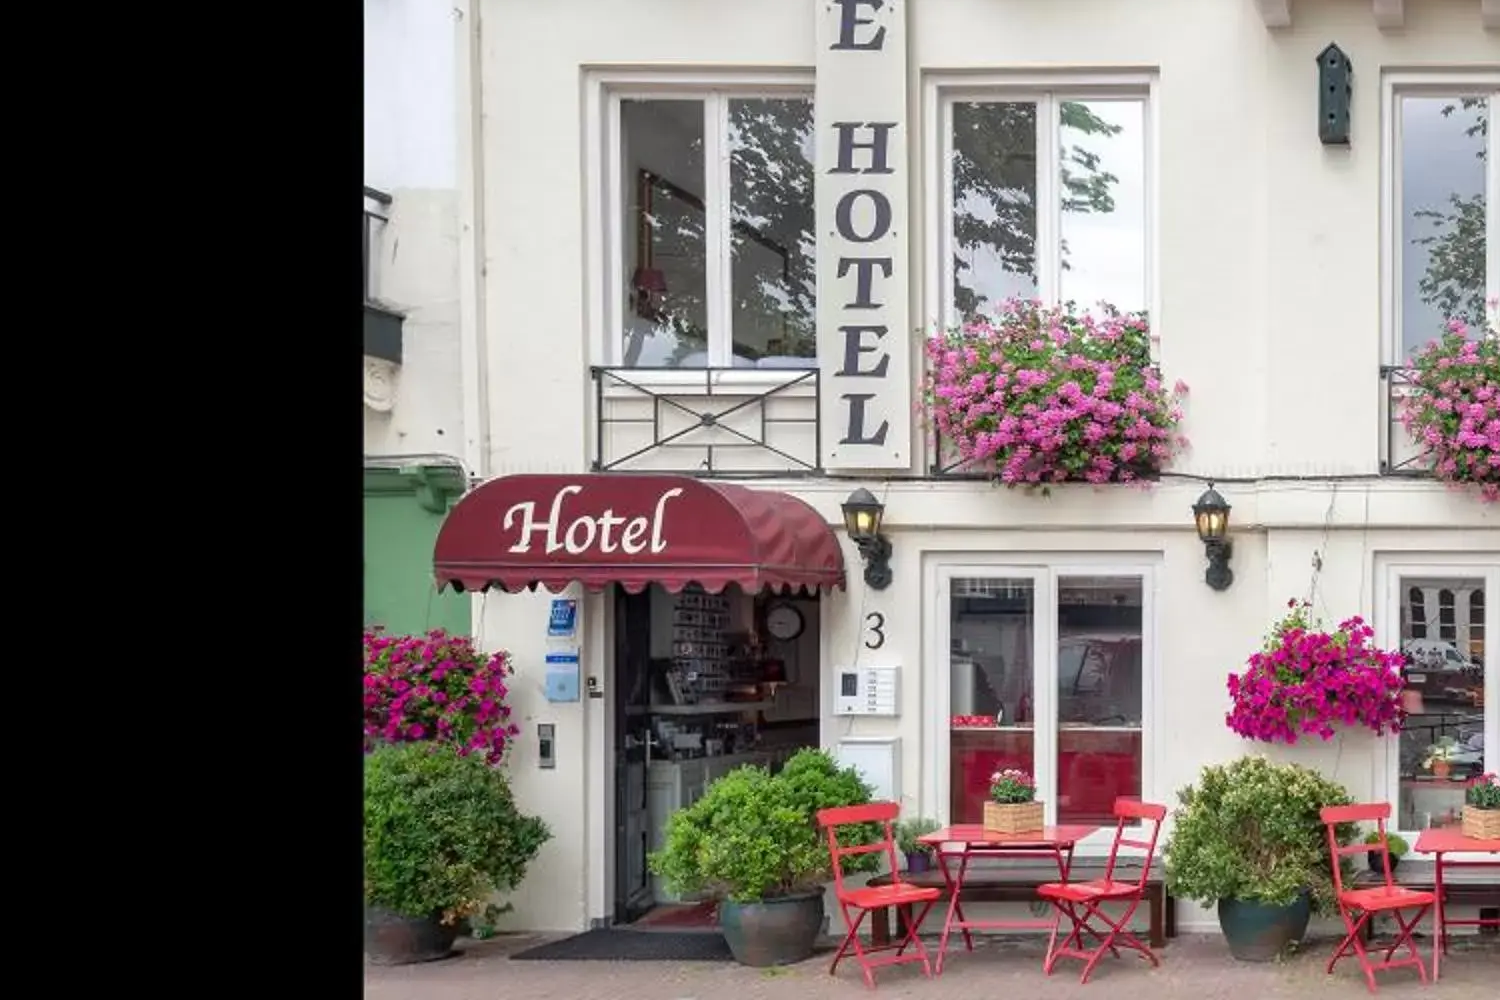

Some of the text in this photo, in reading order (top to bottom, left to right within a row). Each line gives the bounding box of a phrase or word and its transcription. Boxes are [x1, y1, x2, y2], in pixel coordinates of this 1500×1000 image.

[827, 121, 898, 447] HOTEL
[503, 485, 683, 555] Hotel
[865, 611, 885, 650] 3
